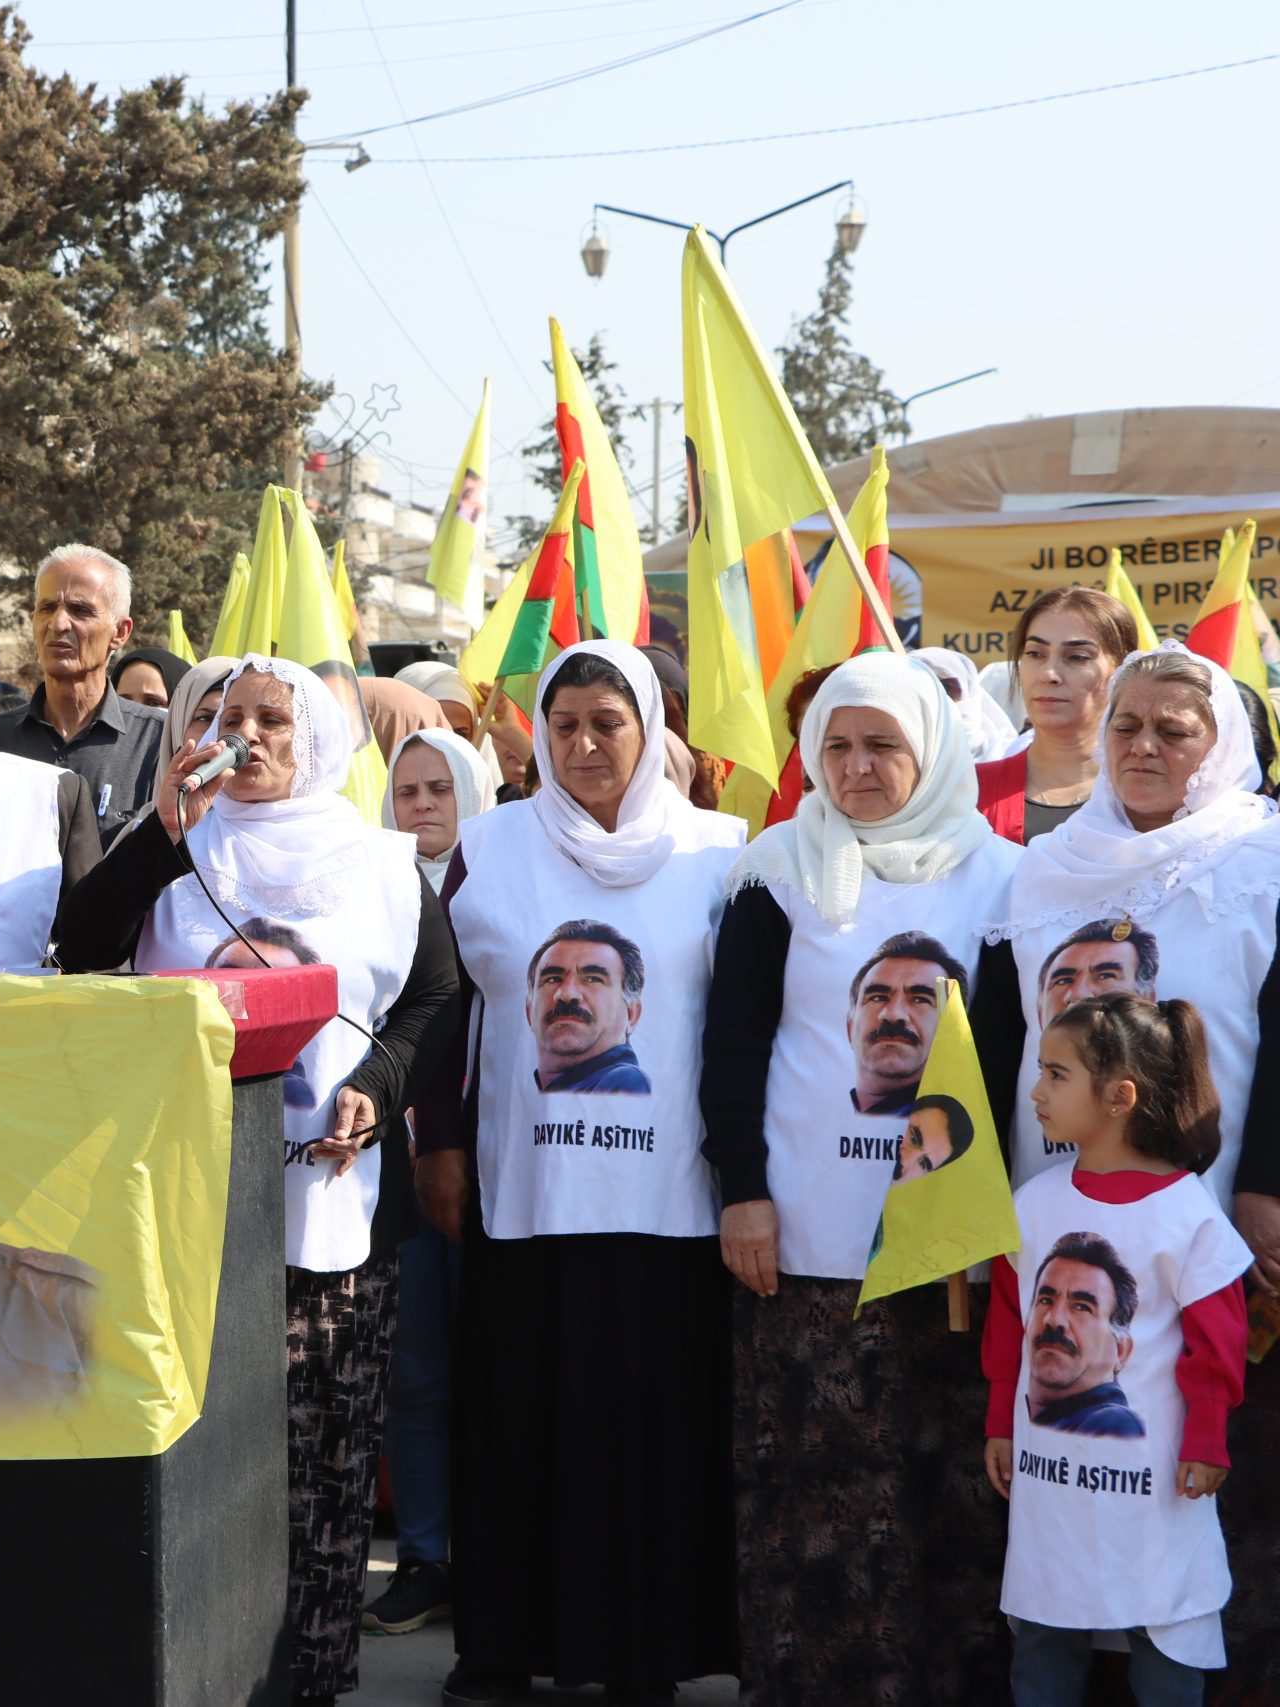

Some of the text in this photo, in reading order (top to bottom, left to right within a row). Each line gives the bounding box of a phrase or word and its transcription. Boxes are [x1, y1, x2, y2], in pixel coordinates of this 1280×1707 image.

[1031, 547, 1054, 570] JI
[1065, 545, 1108, 569] BO
[534, 1119, 585, 1146] DAYIKÊ
[1019, 1449, 1069, 1485] DAYIKÊ
